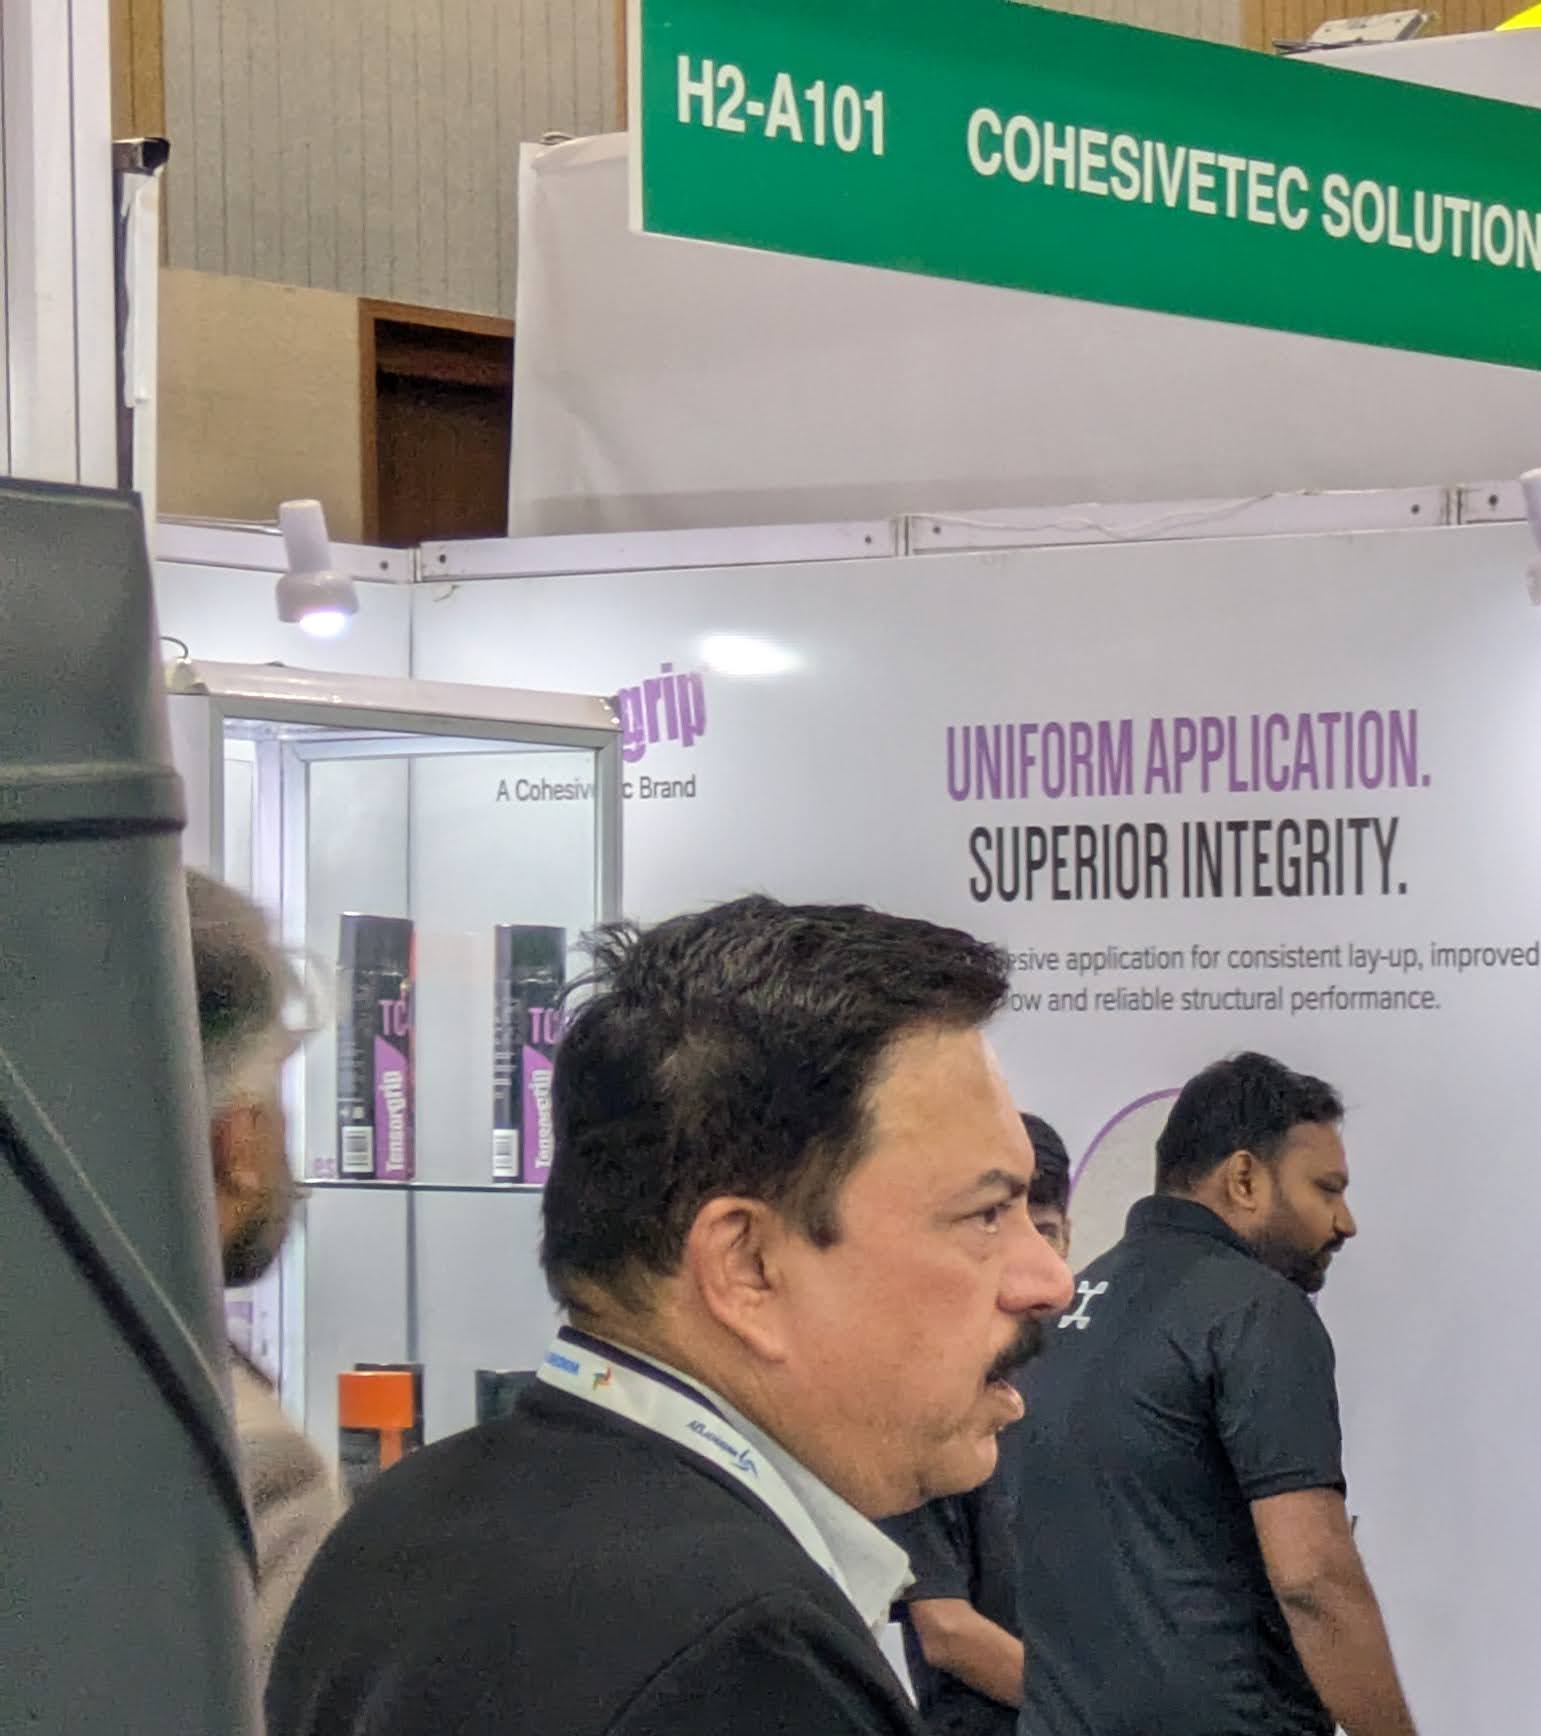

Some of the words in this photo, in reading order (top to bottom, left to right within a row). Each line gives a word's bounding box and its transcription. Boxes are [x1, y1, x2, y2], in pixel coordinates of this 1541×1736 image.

[676, 54, 886, 157] H2-A101
[966, 106, 1310, 232] COHESIVETEC
[946, 719, 1134, 801] UNIFORM
[1144, 708, 1432, 796] APPLICATION.
[496, 779, 510, 802] A
[515, 775, 633, 802] Cohesivc
[639, 773, 697, 799] Brand
[969, 822, 1169, 903] SUPERIOR
[1181, 816, 1408, 898] INTEGRITY.
[1066, 945, 1184, 976] application
[1191, 944, 1220, 970] for
[1227, 945, 1343, 970] consistent
[1348, 942, 1425, 974] lay-up,
[1430, 941, 1540, 973] improved
[1048, 987, 1088, 1012] and
[1094, 986, 1174, 1011] reliable
[1181, 985, 1284, 1011] structural
[1290, 985, 1441, 1015] performance.
